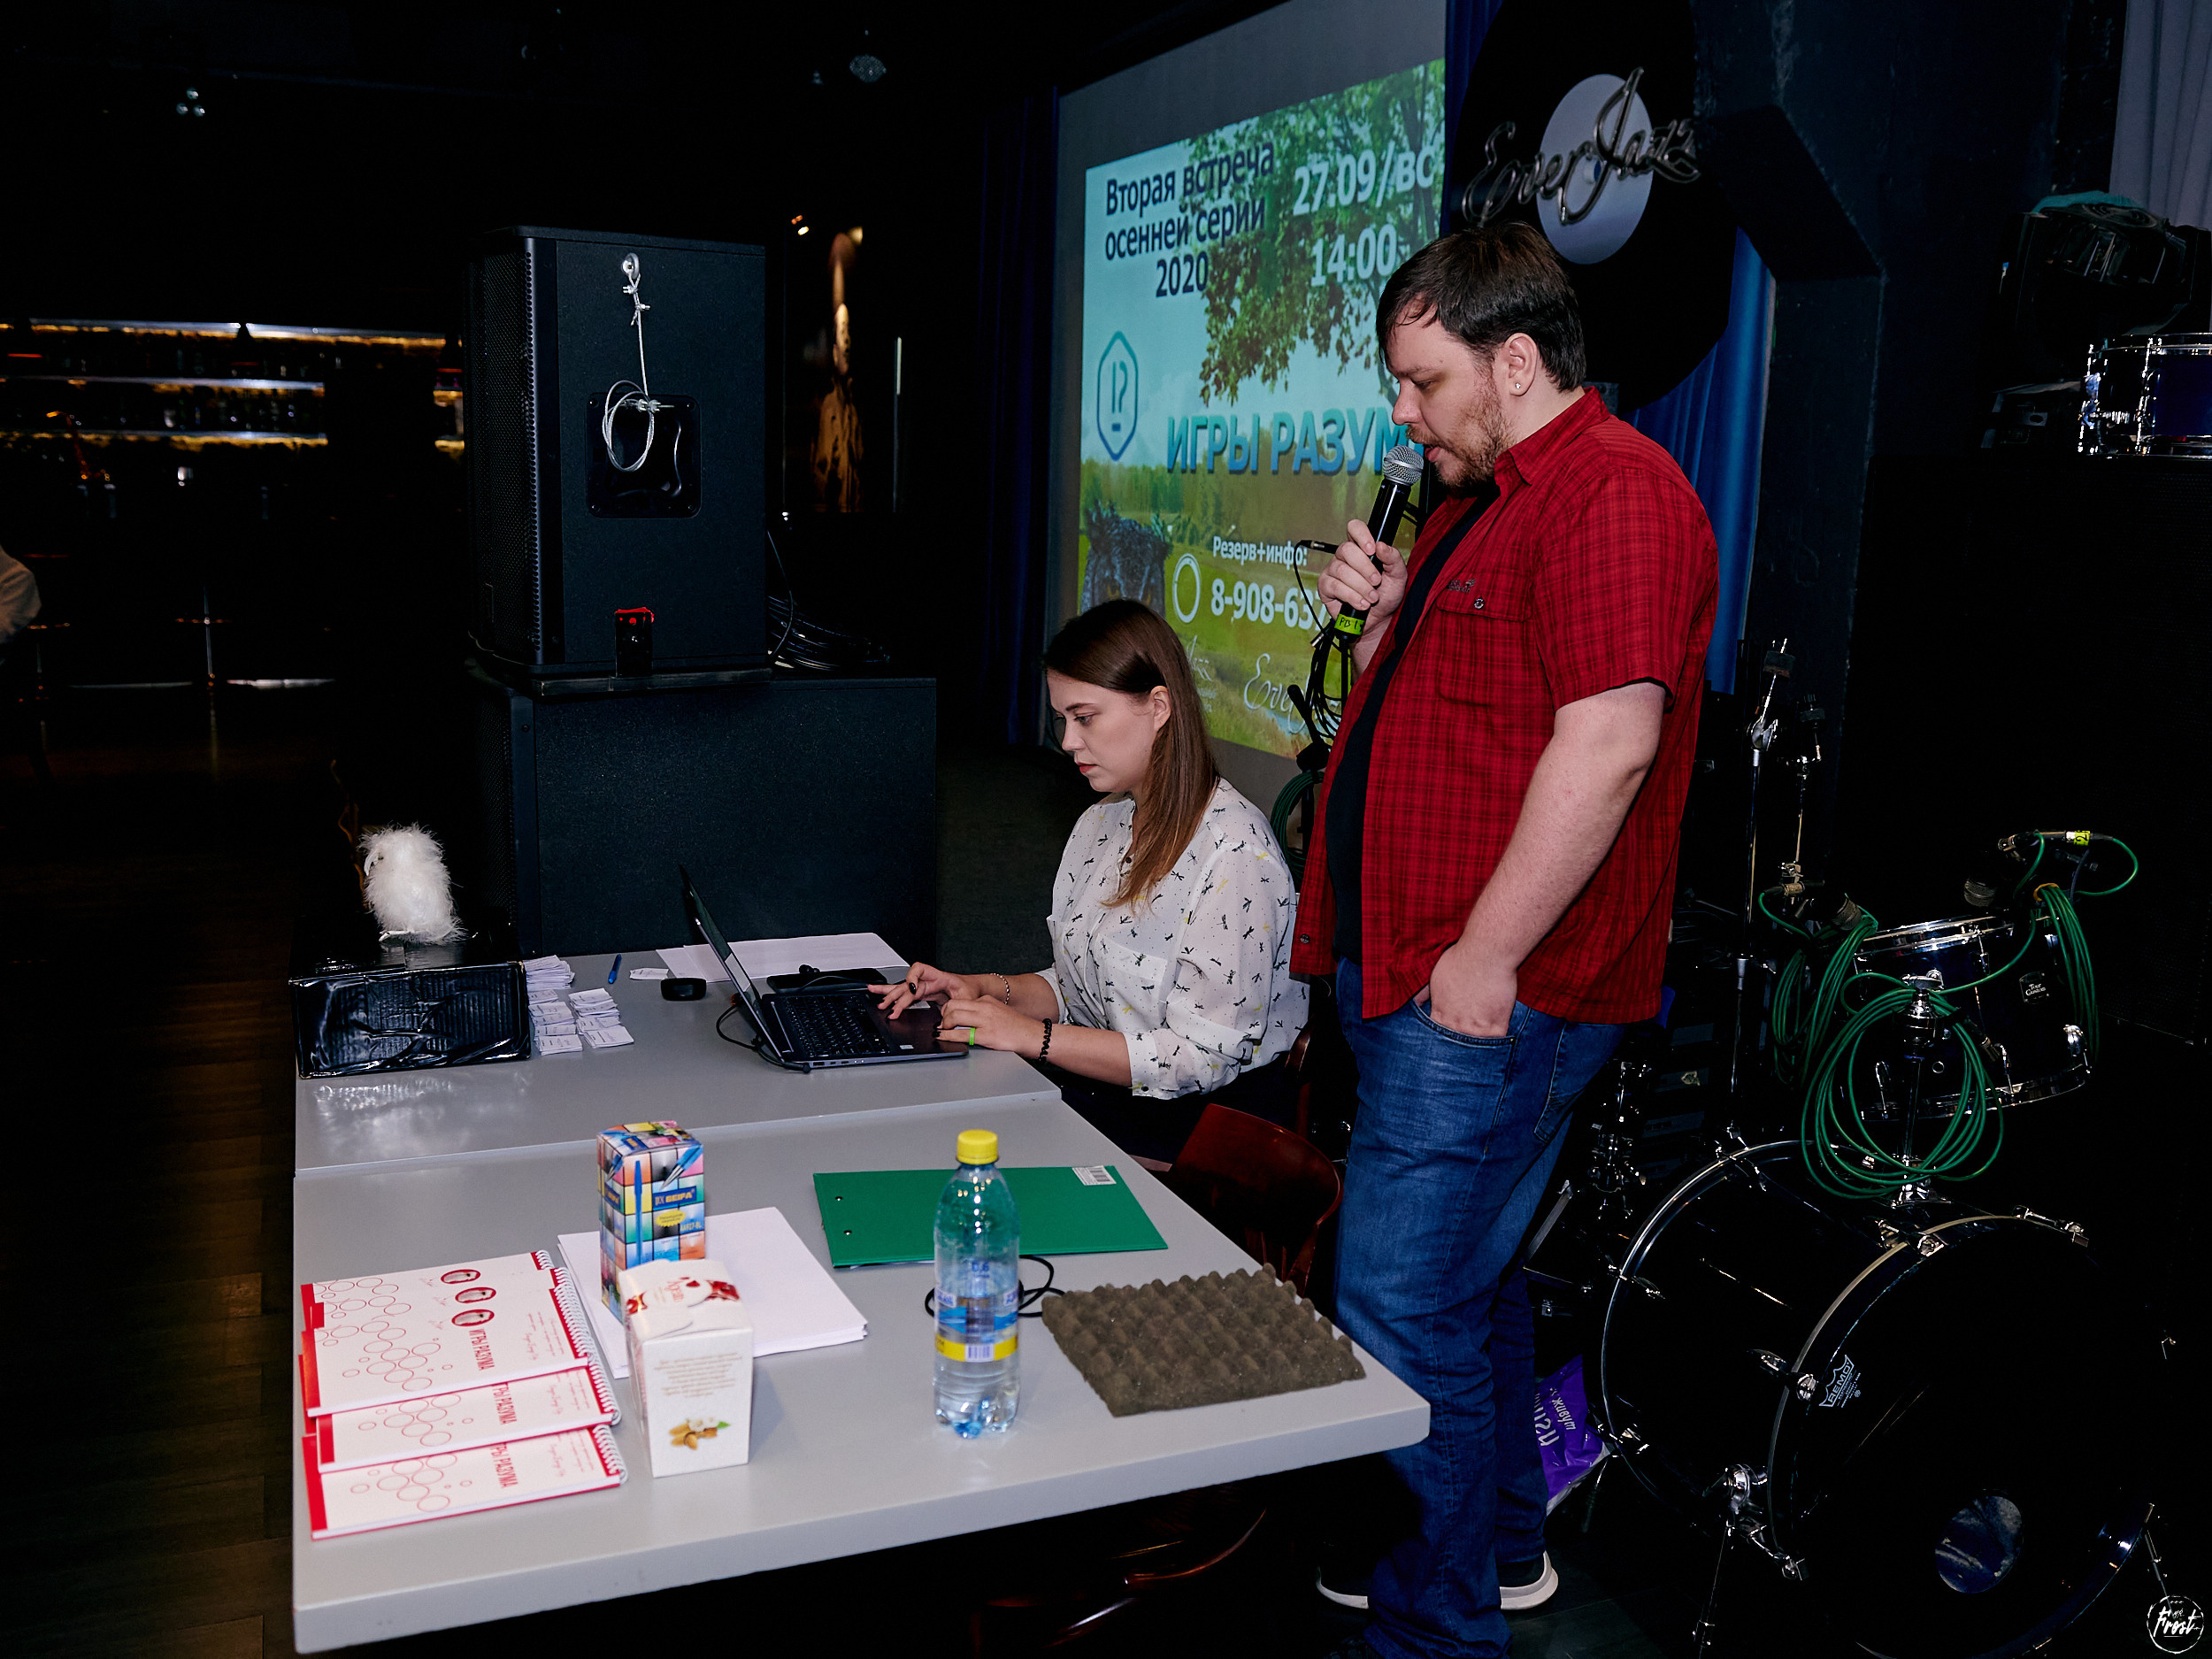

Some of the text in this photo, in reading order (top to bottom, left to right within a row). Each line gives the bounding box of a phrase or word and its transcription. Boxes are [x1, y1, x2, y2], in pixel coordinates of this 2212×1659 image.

[1106, 142, 1274, 217] Вторая встреча
[1105, 197, 1265, 260] осенней серии
[1311, 224, 1397, 288] 14:00
[1156, 251, 1209, 298] 2020
[1167, 408, 1424, 475] ИГРЫ РАЗУМ
[1213, 536, 1308, 571] Резерв+инфо:
[1827, 1364, 1851, 1403] REMO
[1551, 1396, 1577, 1430] живут
